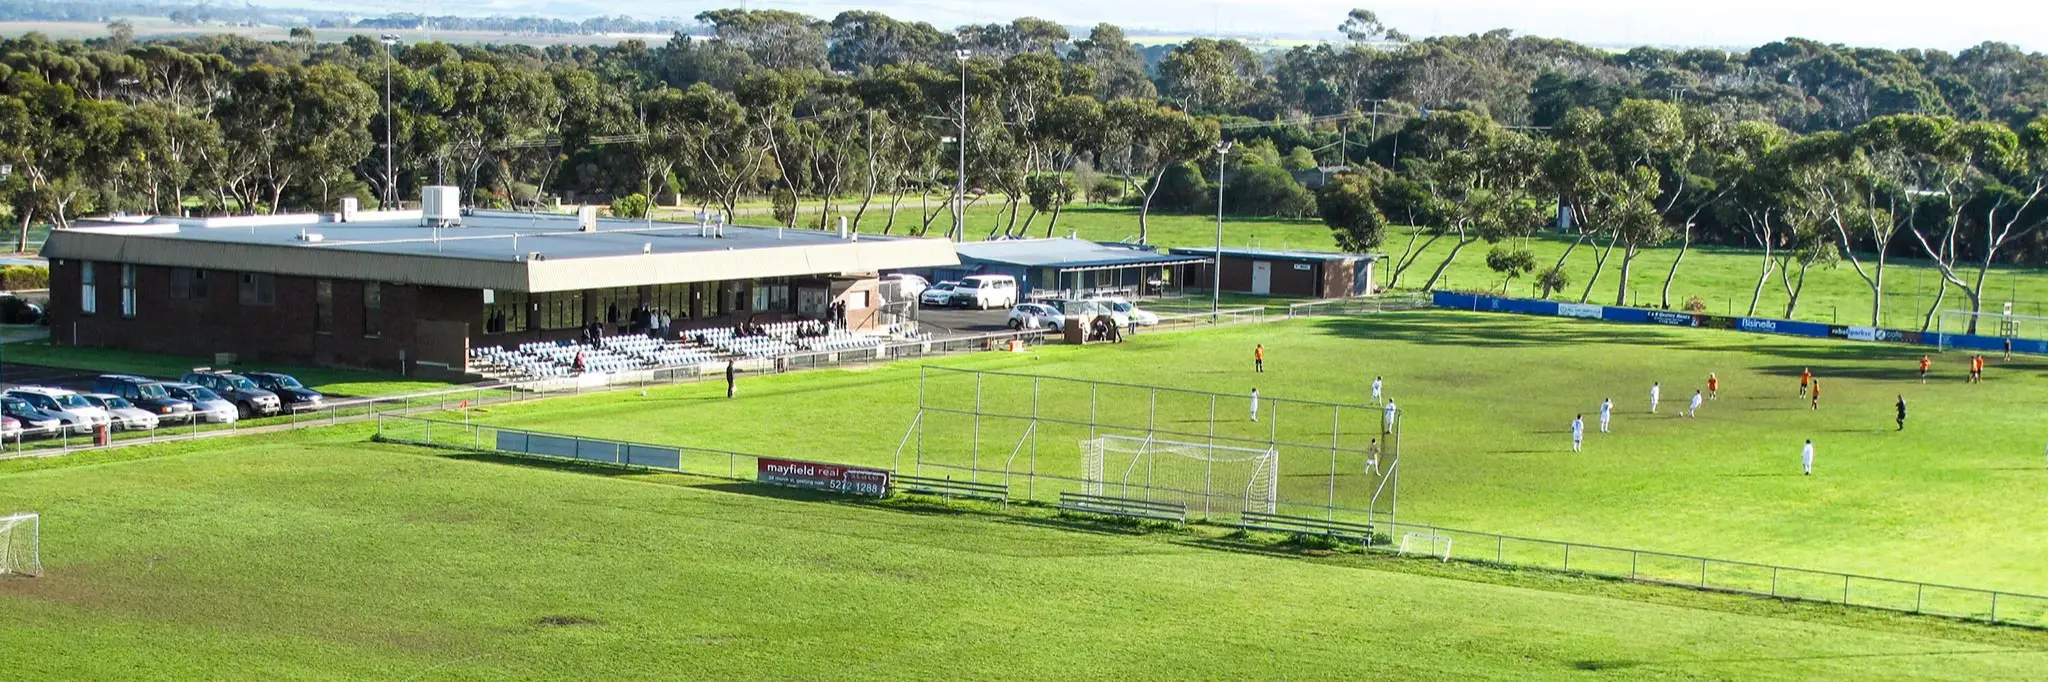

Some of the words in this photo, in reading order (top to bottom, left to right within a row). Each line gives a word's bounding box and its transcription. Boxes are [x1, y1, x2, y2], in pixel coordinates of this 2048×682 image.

[767, 464, 815, 476] mayfield
[818, 468, 839, 477] real
[856, 482, 878, 493] 1288
